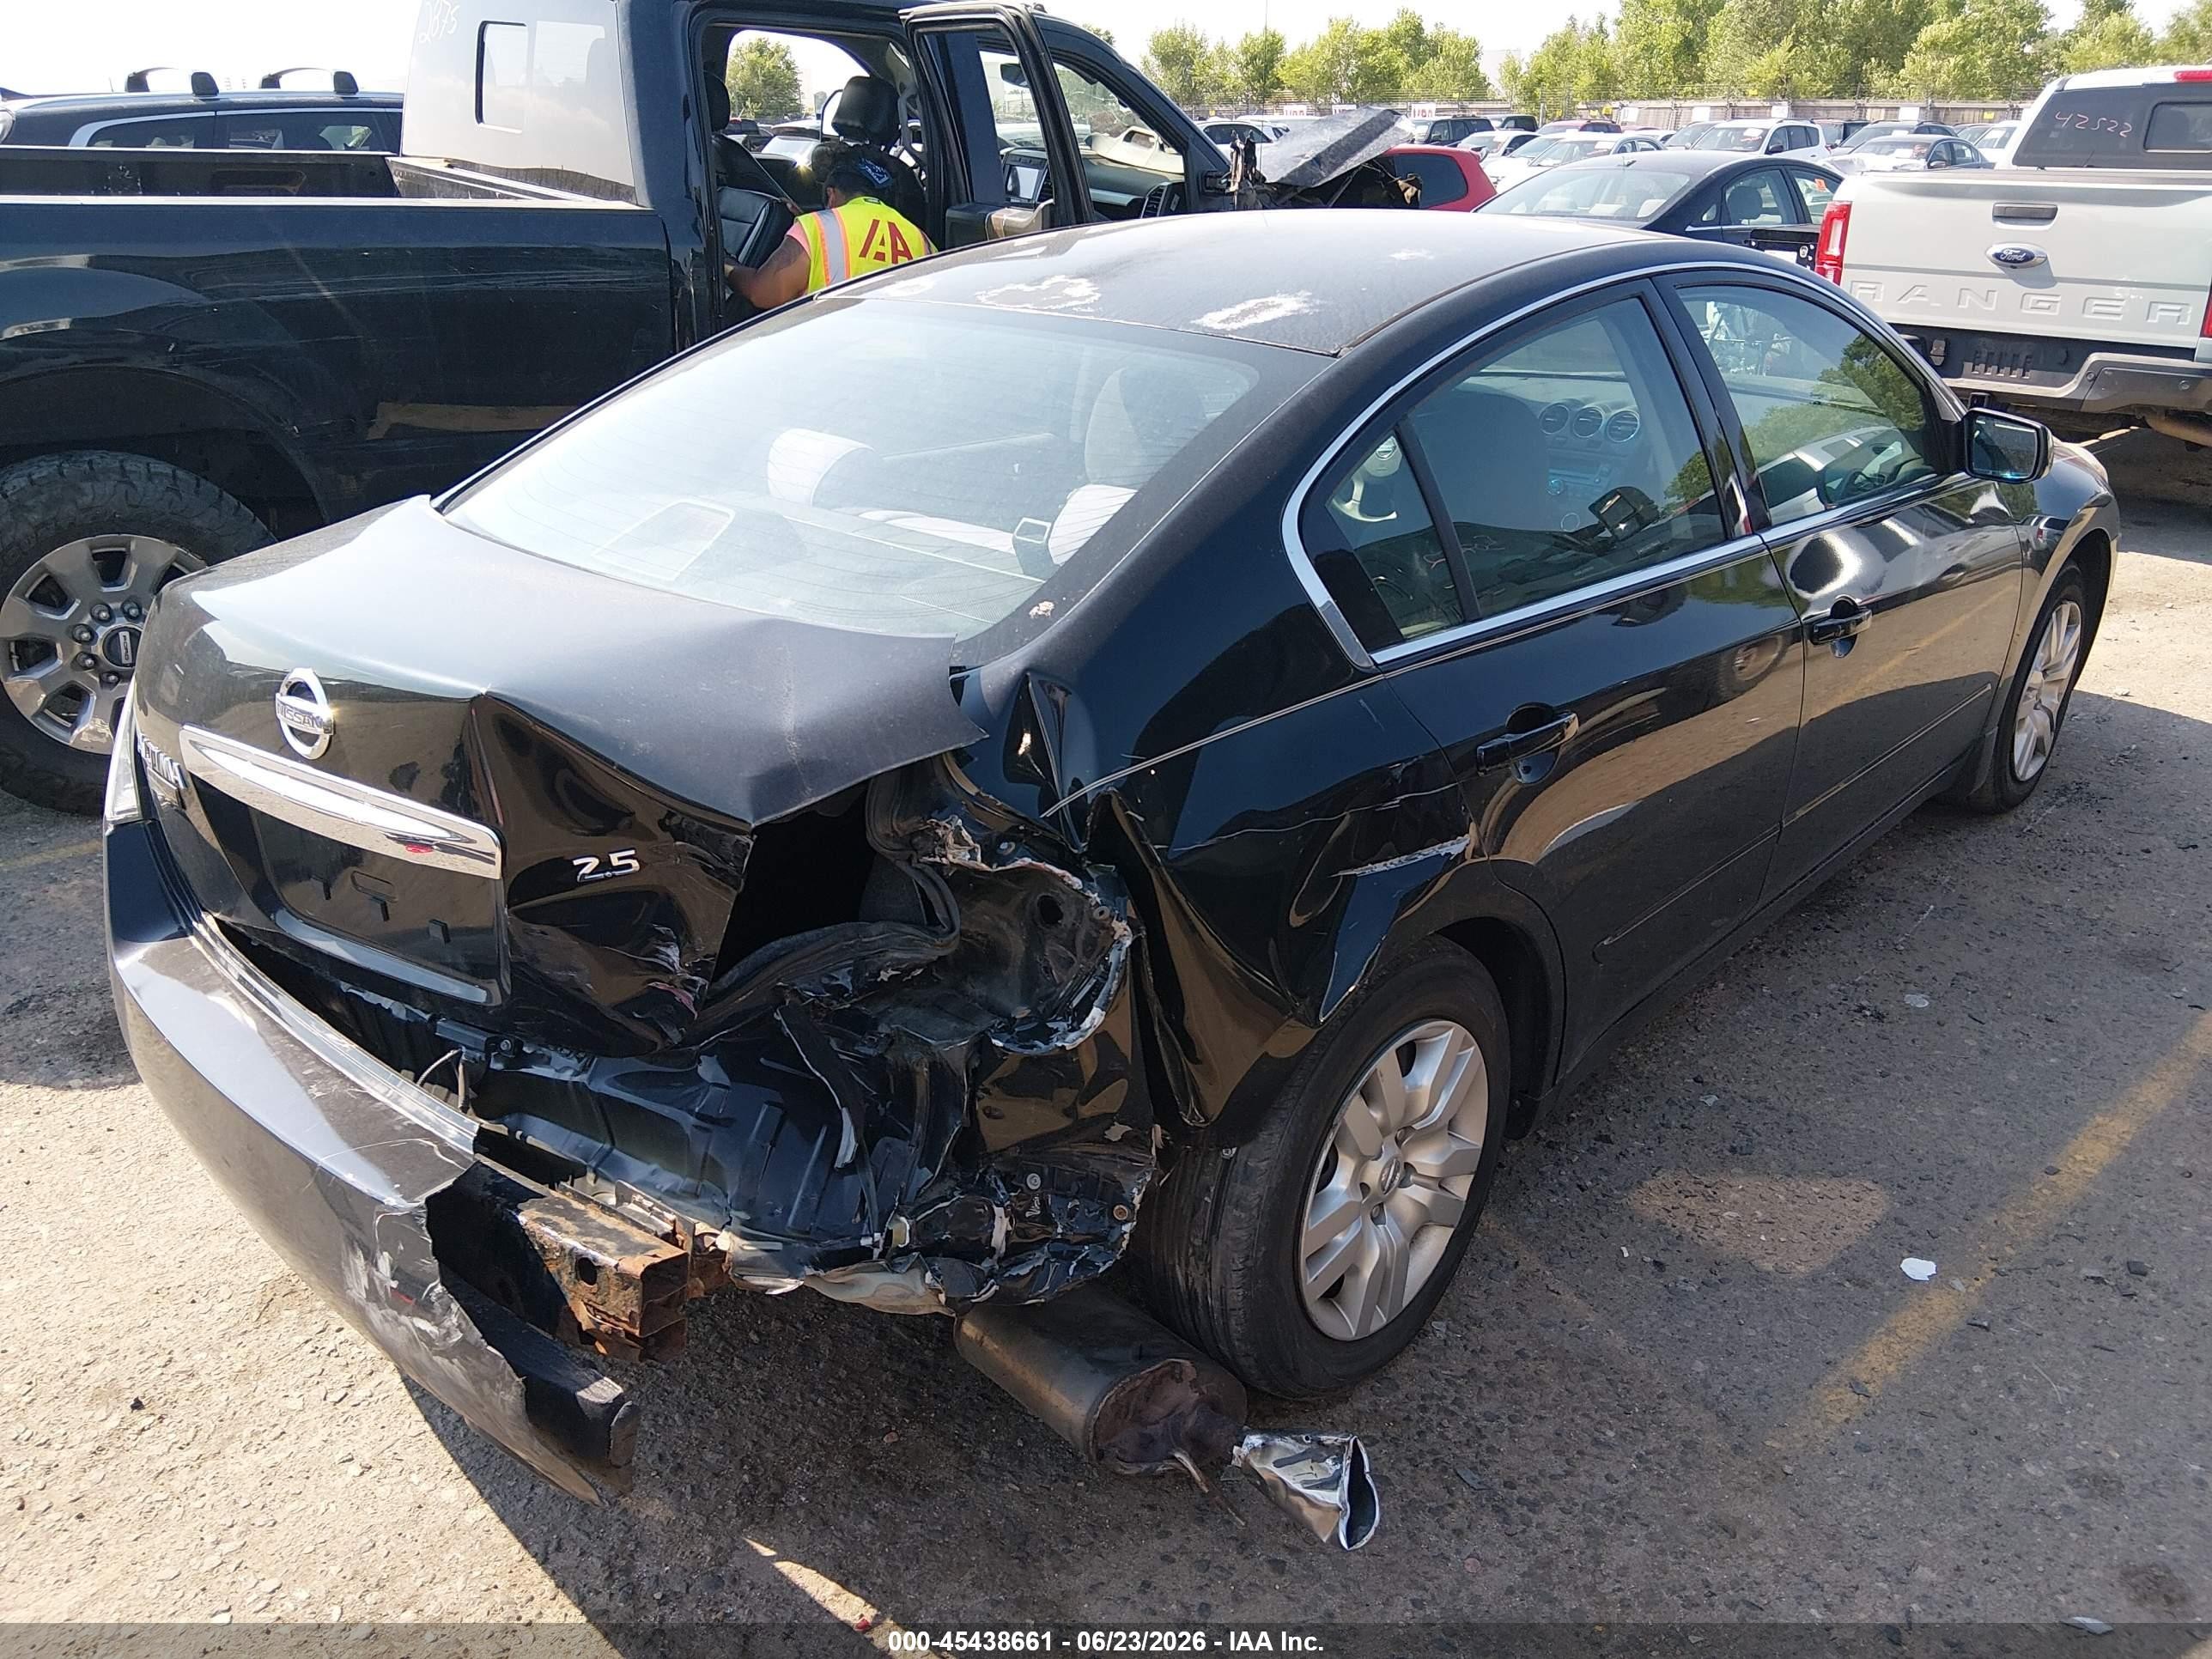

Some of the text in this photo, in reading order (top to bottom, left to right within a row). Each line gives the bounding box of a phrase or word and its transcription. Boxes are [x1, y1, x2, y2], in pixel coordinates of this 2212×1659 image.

[1999, 249, 2027, 262] Ford
[1850, 281, 2192, 325] RANGER
[276, 699, 325, 729] NISSAN
[572, 848, 641, 883] 2.5
